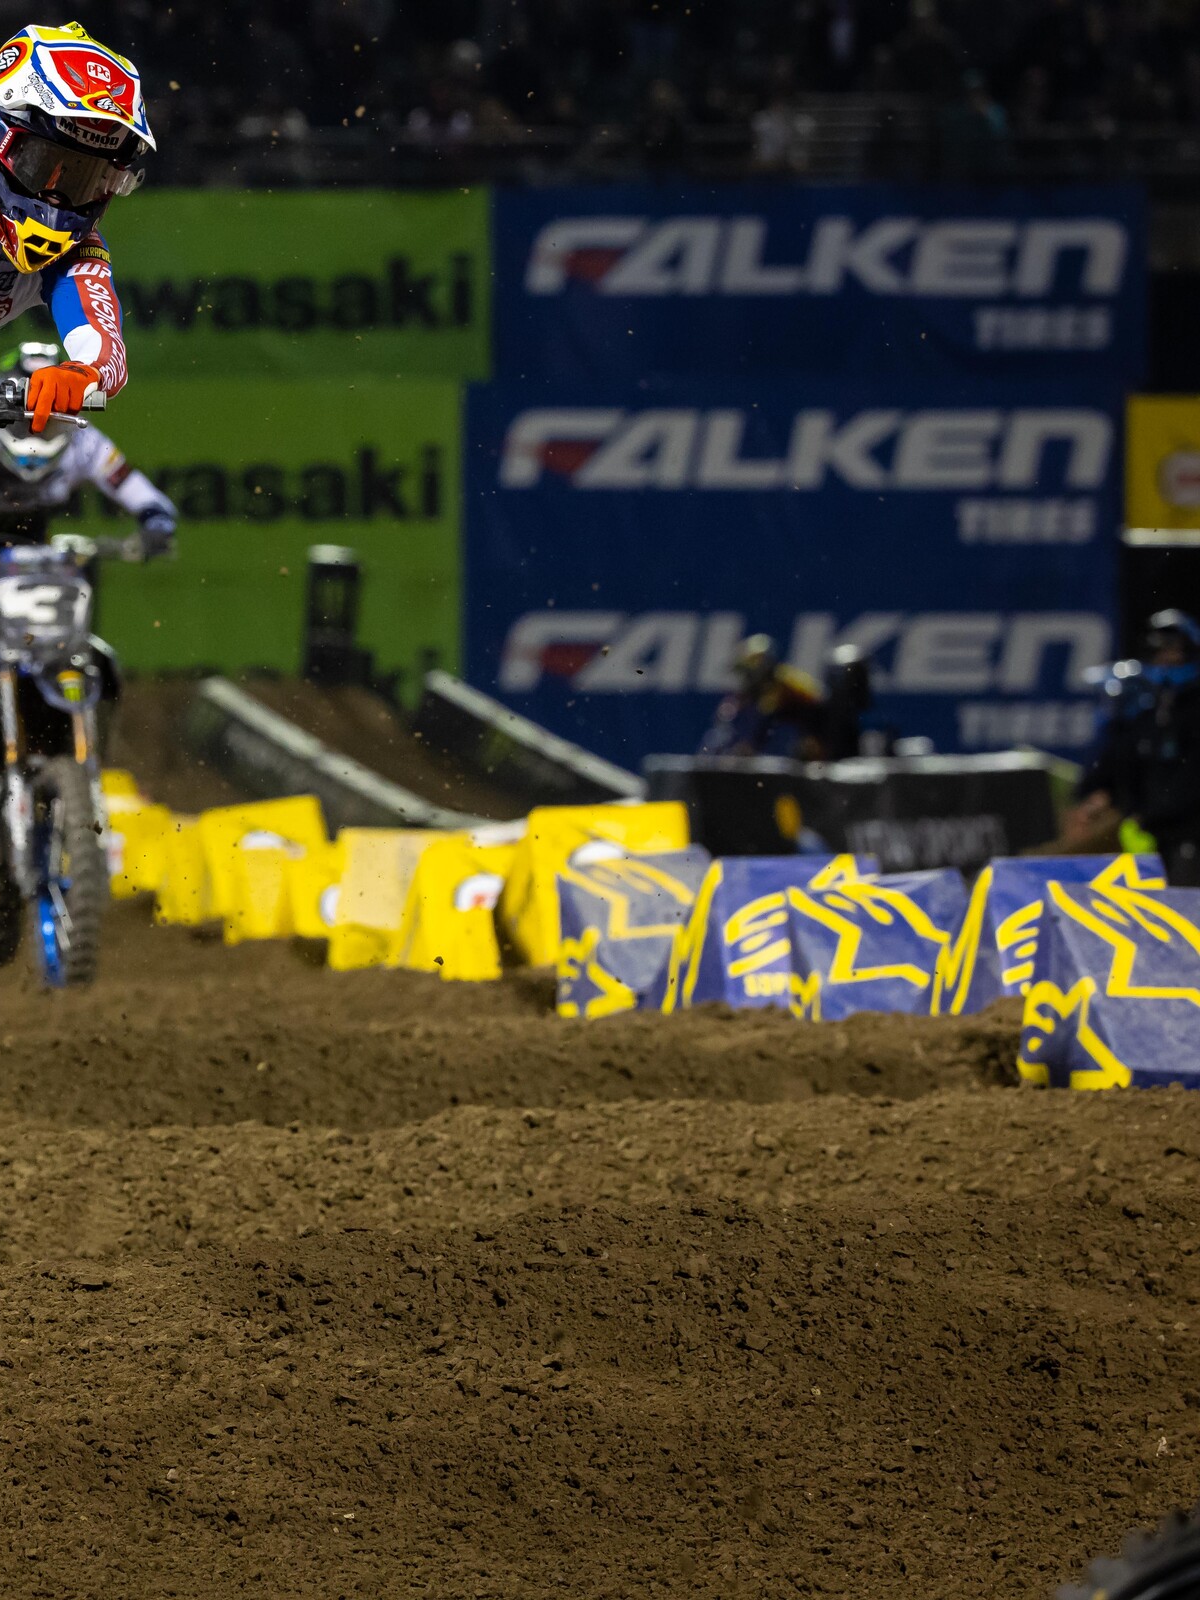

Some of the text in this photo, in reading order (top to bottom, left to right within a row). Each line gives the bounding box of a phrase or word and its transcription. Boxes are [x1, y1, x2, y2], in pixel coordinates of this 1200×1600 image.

[87, 63, 111, 81] PPG
[59, 118, 120, 146] METHOD
[527, 217, 1128, 296] FALKEN
[120, 254, 472, 332] wasaki
[975, 309, 1112, 350] TIRES
[499, 409, 1115, 489] FALKEN
[959, 500, 1095, 544] TIRES
[498, 610, 1114, 692] FALKEN
